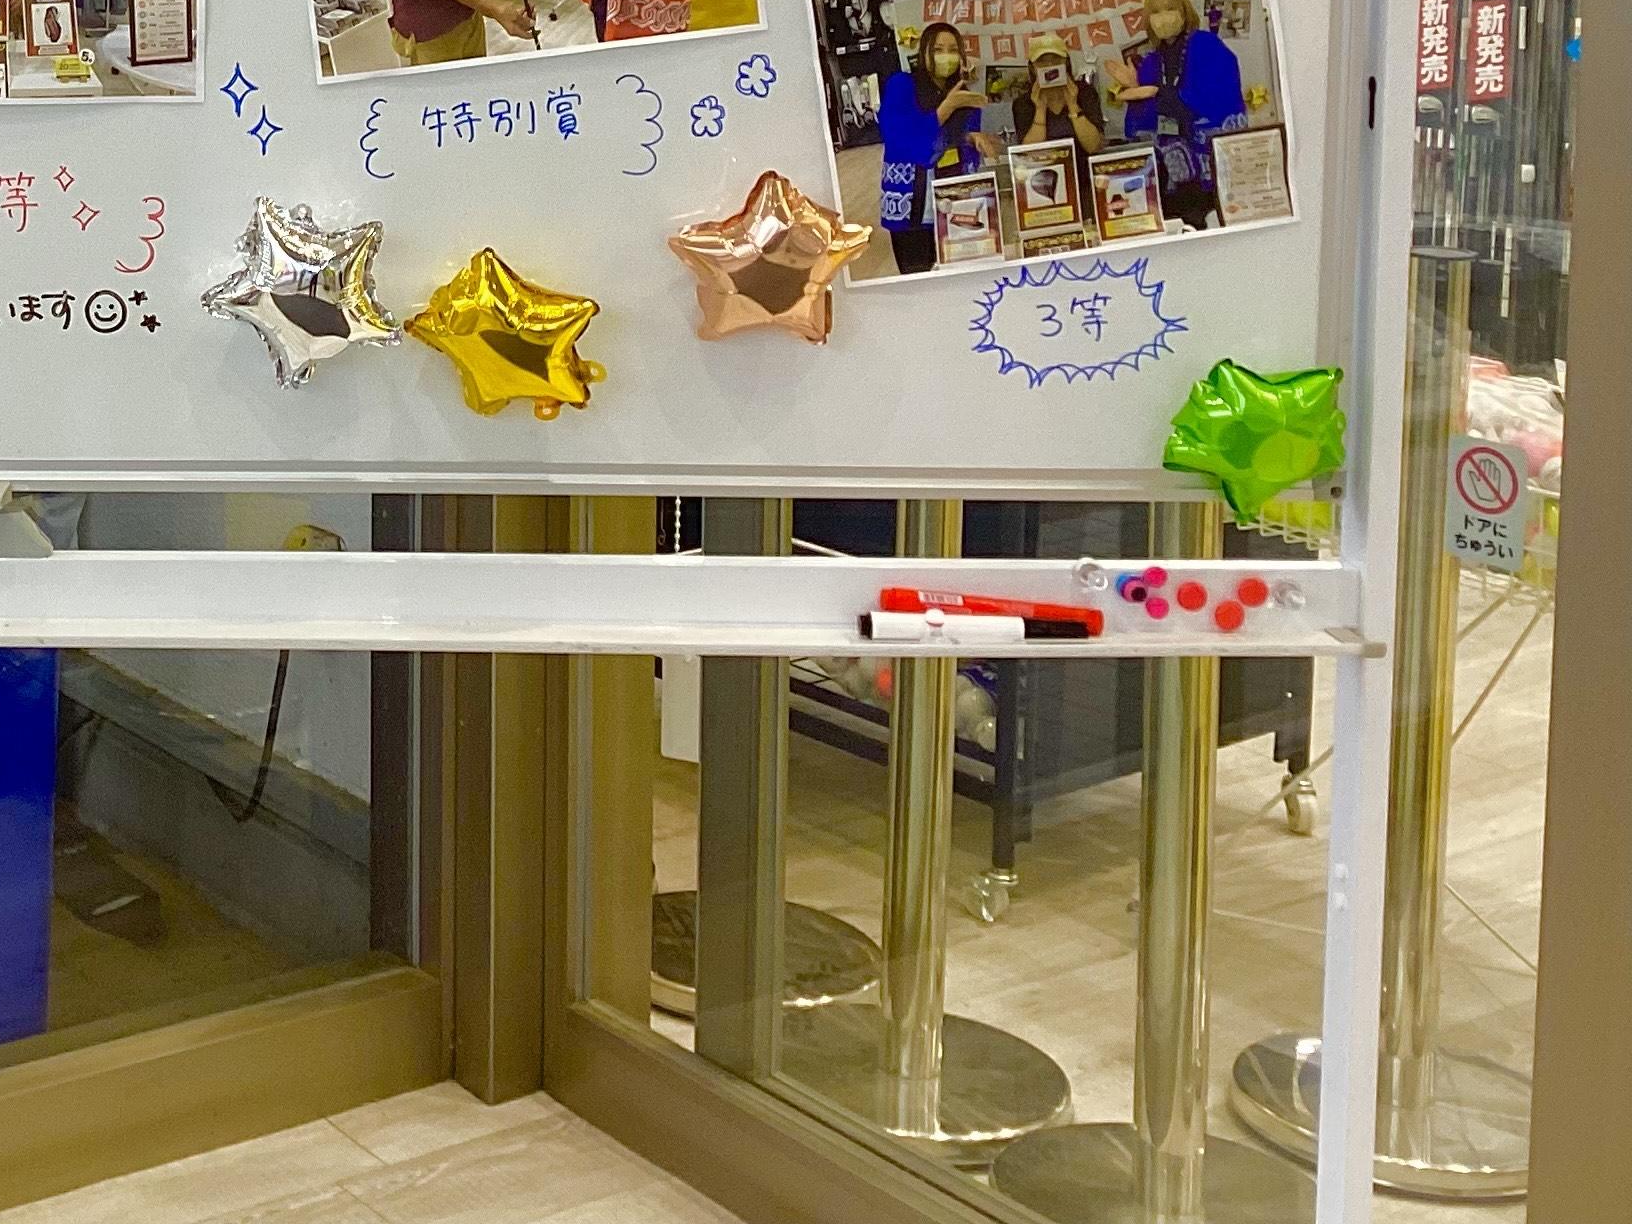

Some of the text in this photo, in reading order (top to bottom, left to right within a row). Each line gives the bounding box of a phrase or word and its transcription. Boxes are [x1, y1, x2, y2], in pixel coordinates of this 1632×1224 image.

[1475, 5, 1505, 96] 新発売
[421, 82, 582, 147] 特別賞
[1035, 291, 1113, 342] 3等
[1454, 533, 1514, 559] ちゅうい
[1463, 514, 1508, 539] ドアに
